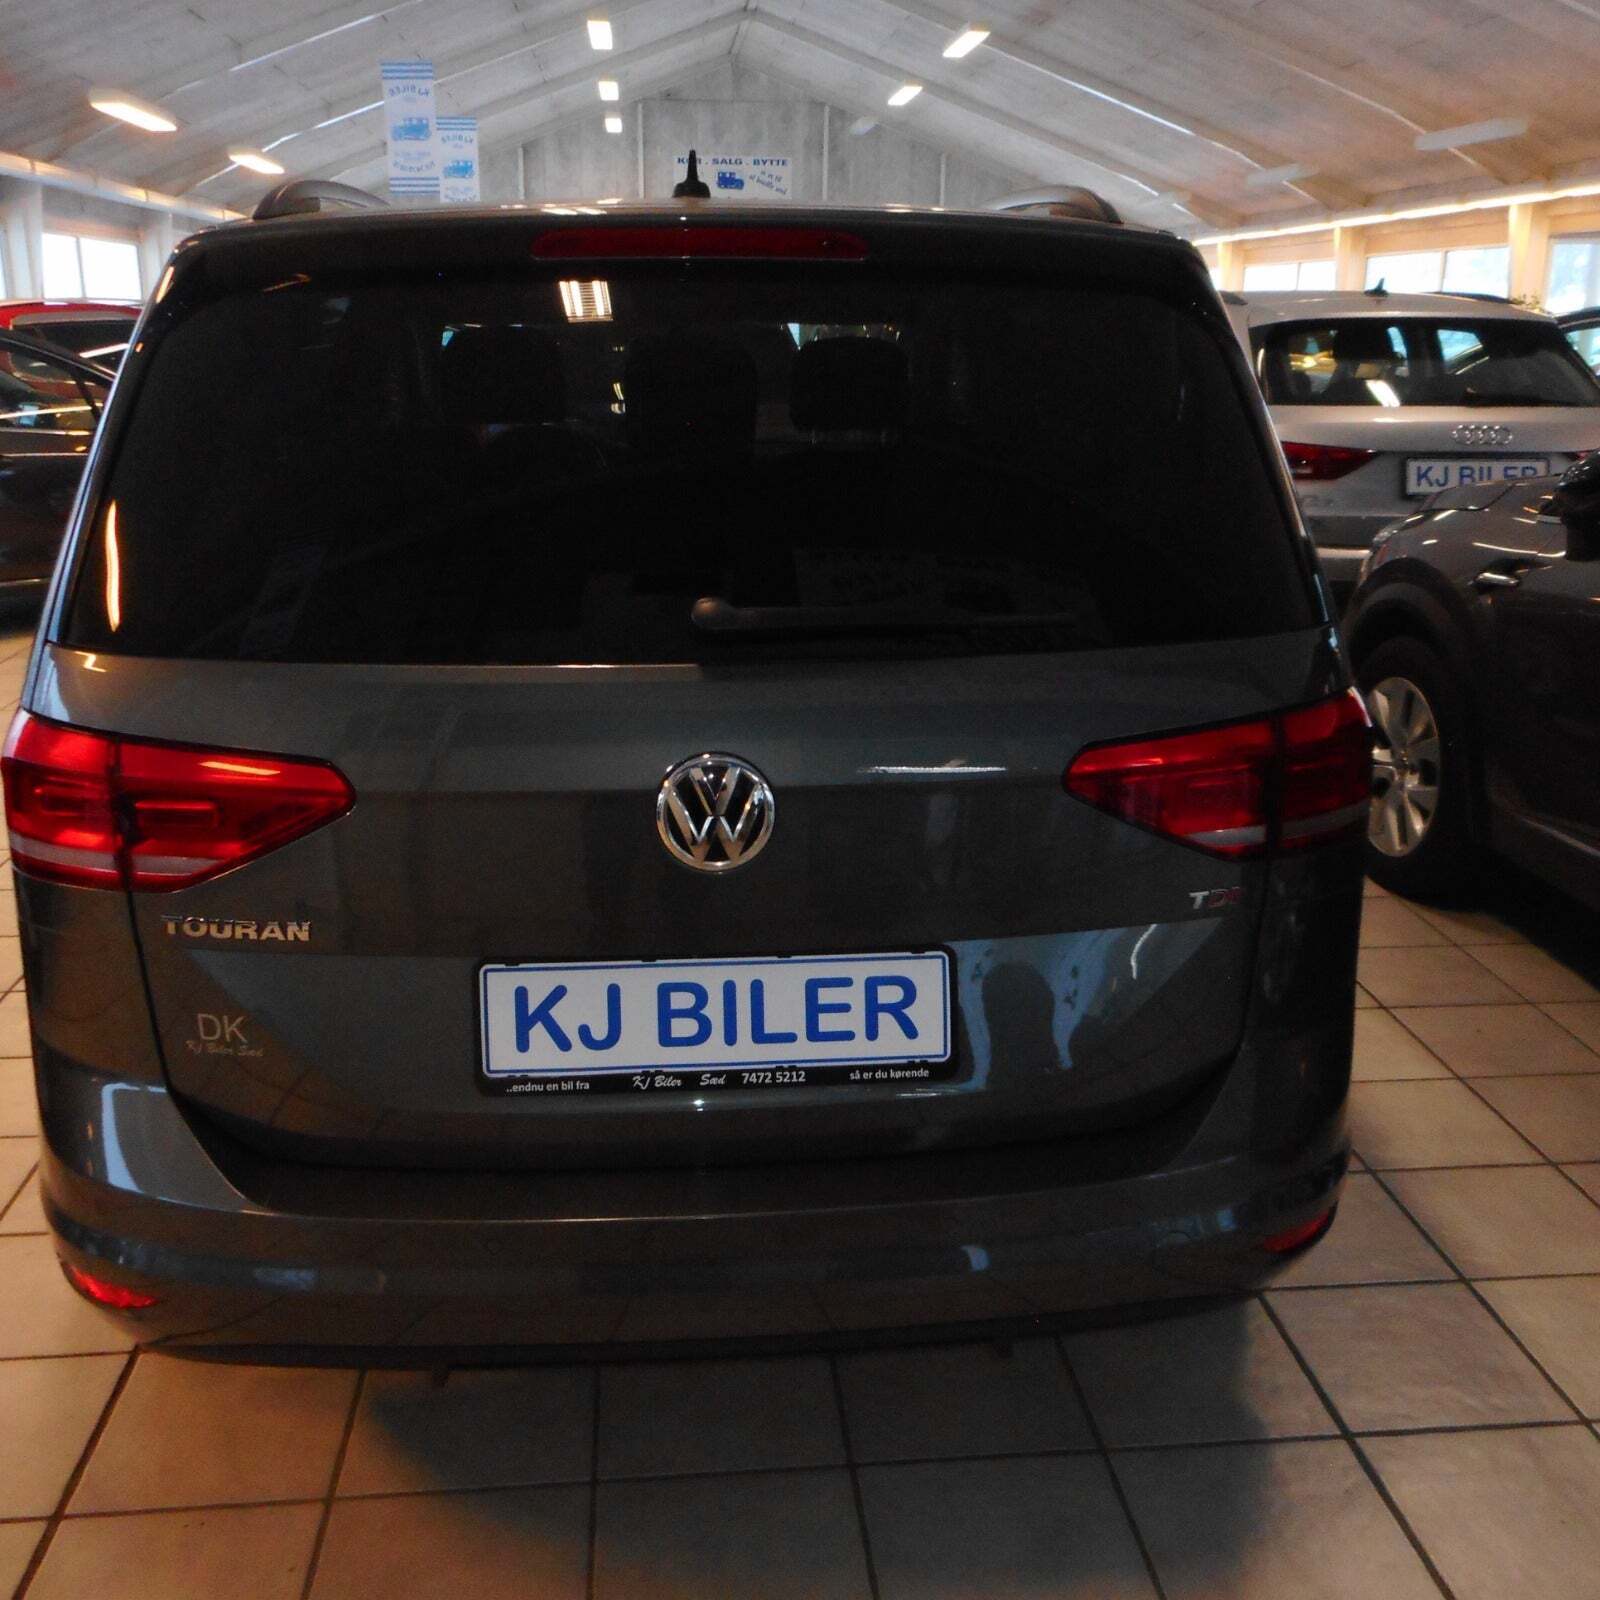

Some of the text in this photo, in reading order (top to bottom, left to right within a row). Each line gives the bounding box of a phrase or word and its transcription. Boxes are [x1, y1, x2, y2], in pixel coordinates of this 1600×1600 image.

[712, 158, 743, 166] SALG
[753, 158, 787, 166] BYTTE
[1416, 465, 1449, 488] KJ
[160, 915, 310, 942] TOURAN
[514, 975, 919, 1053] KJ BILER
[197, 1013, 249, 1043] DK
[546, 1082, 559, 1091] en
[561, 1080, 573, 1091] bil
[576, 1080, 589, 1090] fra
[632, 1075, 650, 1090] KJ
[654, 1074, 682, 1088] Biler
[742, 1072, 773, 1085] 7472
[775, 1070, 806, 1083] 5212
[849, 1069, 860, 1080] så
[862, 1071, 873, 1080] er
[874, 1069, 888, 1079] du
[890, 1067, 929, 1079] kørende
